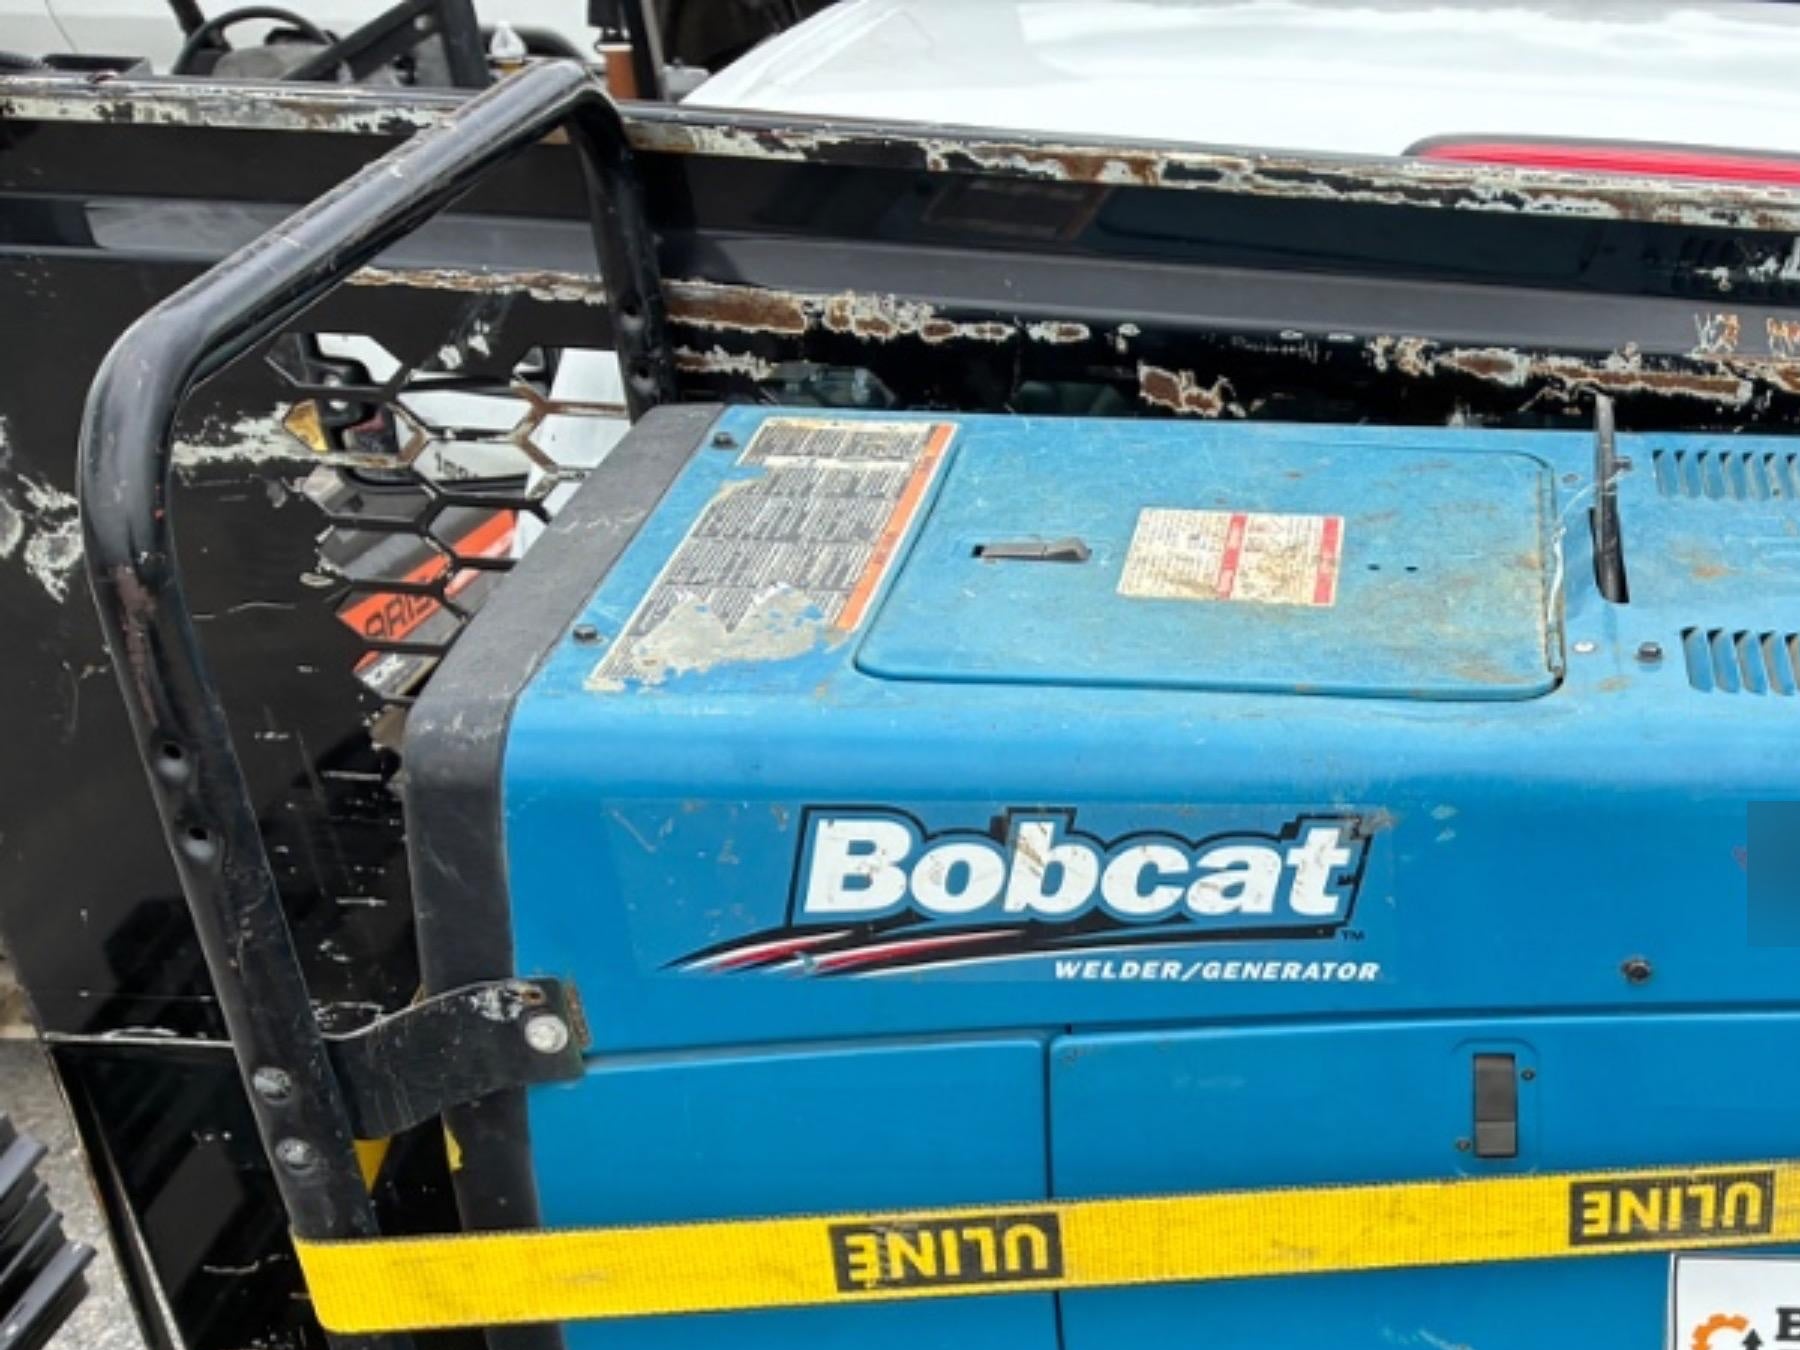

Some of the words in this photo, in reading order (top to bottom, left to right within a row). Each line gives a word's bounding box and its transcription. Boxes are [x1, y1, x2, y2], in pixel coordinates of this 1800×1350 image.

[801, 817, 1353, 916] Bobcat
[1054, 959, 1381, 983] WELDER/GENERATOR
[1582, 1180, 1762, 1237] ULINE
[844, 1222, 1049, 1283] ULINE
